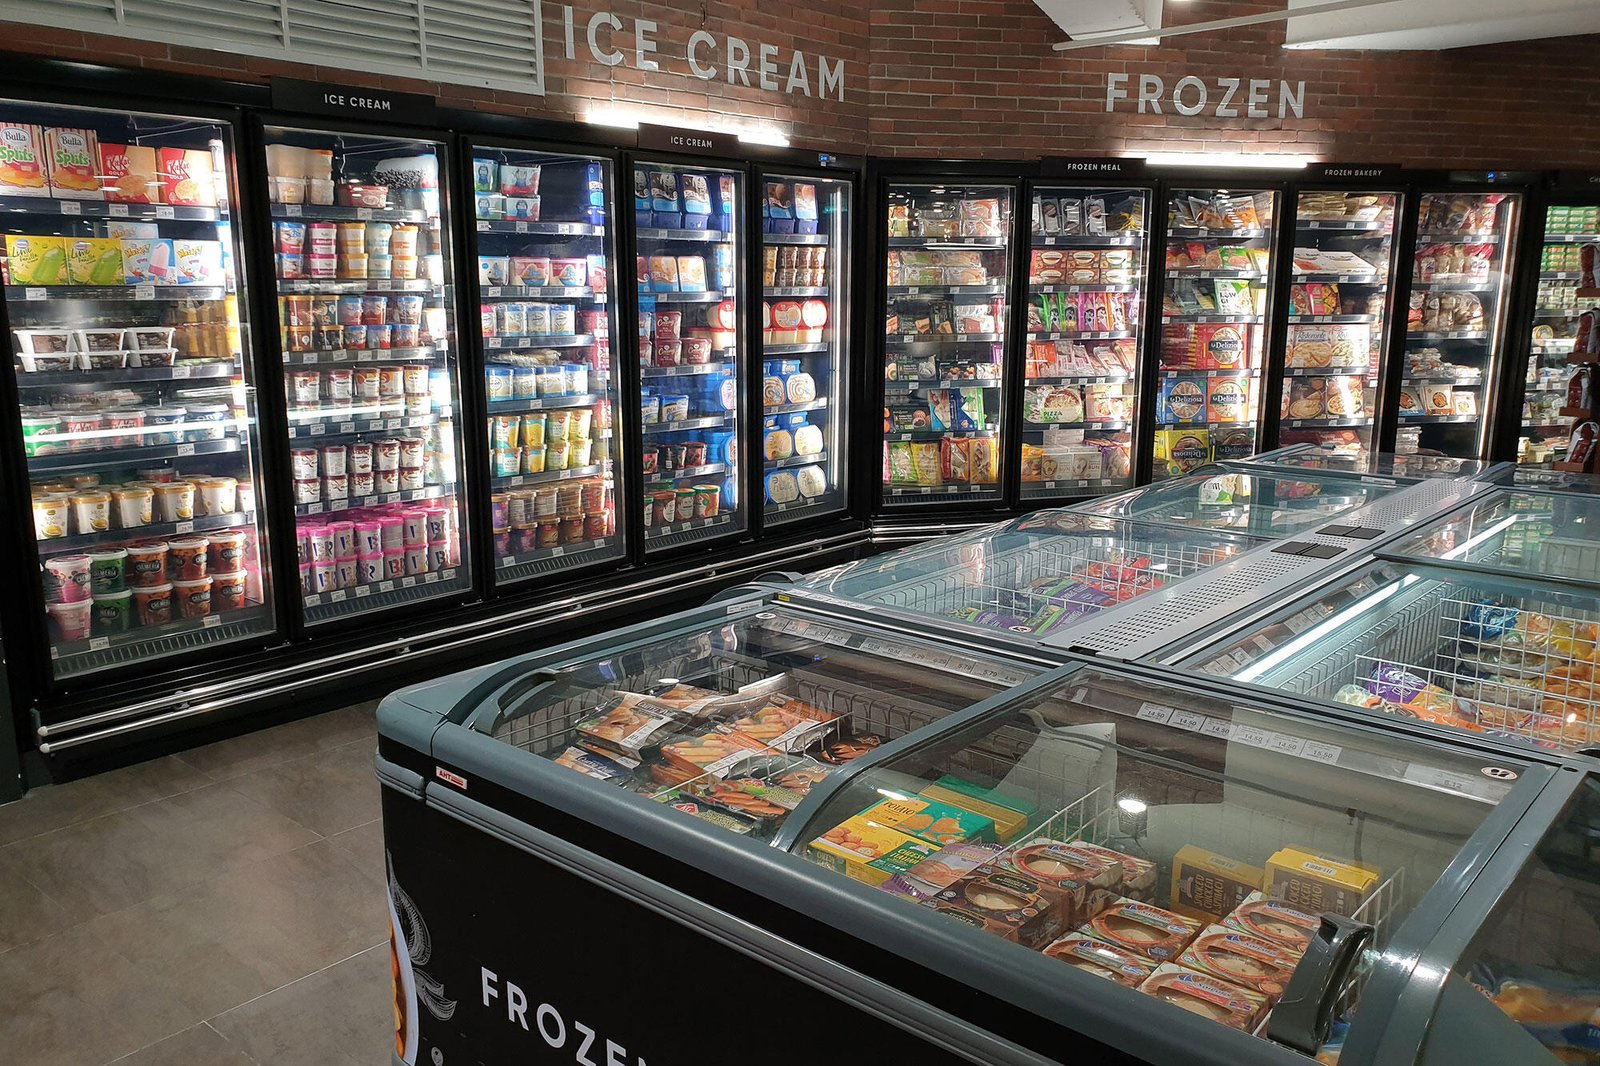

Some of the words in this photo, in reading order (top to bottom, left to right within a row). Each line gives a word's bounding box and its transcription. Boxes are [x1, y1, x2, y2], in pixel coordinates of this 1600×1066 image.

[564, 5, 659, 72] ICE
[687, 30, 845, 102] CREAM
[1105, 72, 1306, 119] FROZEN
[324, 93, 345, 106] ICE
[350, 97, 391, 111] CREAM
[5, 131, 26, 141] Bulla
[61, 136, 82, 146] Bulla
[670, 136, 684, 145] ICE
[686, 137, 713, 148] CREAM
[0, 146, 34, 163] Splits
[56, 150, 90, 166] Splits
[1067, 163, 1098, 171] FROZEN
[1354, 169, 1383, 177] BAKERY
[1147, 710, 1165, 719] 14.50
[1179, 718, 1197, 726] 14.50
[1212, 725, 1230, 734] 14.50
[1245, 733, 1263, 742] 14.50
[1278, 741, 1297, 750] 14.50
[1313, 749, 1333, 759] 15.50
[439, 770, 452, 780] AHT
[481, 966, 646, 1066] FROZE
